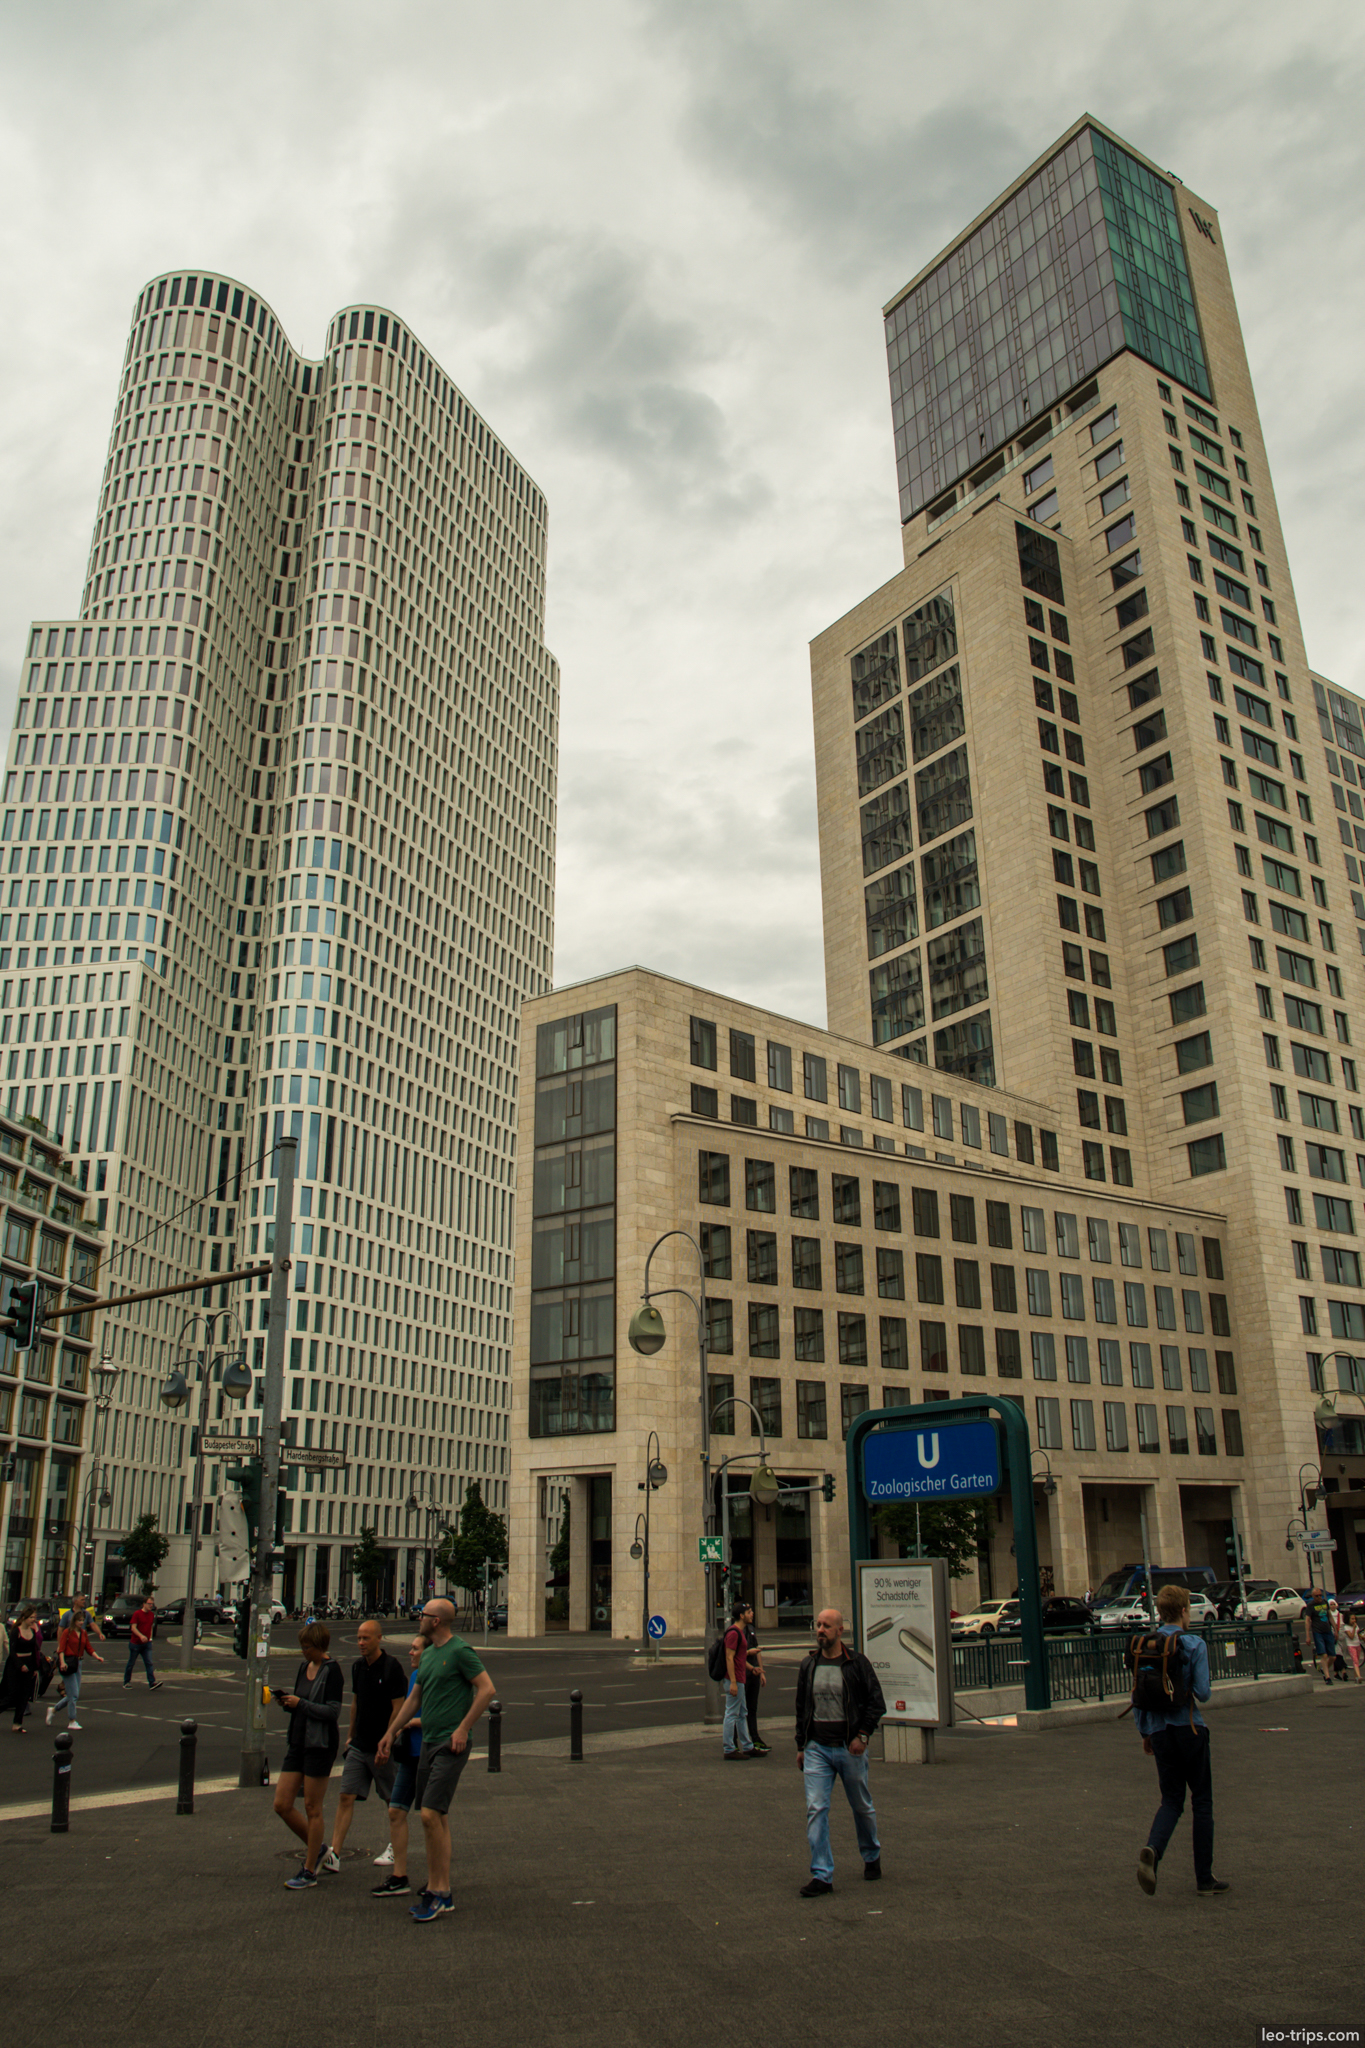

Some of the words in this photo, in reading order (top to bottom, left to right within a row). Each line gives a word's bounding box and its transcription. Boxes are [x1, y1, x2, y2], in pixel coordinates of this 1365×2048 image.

[204, 1439, 236, 1451] Budapester
[236, 1440, 255, 1451] Straße
[917, 1432, 940, 1469] U
[286, 1449, 340, 1465] Hardenbergstraße
[871, 1475, 946, 1497] Zoologischer
[950, 1474, 993, 1490] Garten
[893, 1577, 921, 1589] weniger
[876, 1591, 920, 1601] Schadstoffe.
[871, 1661, 891, 1669] QOS
